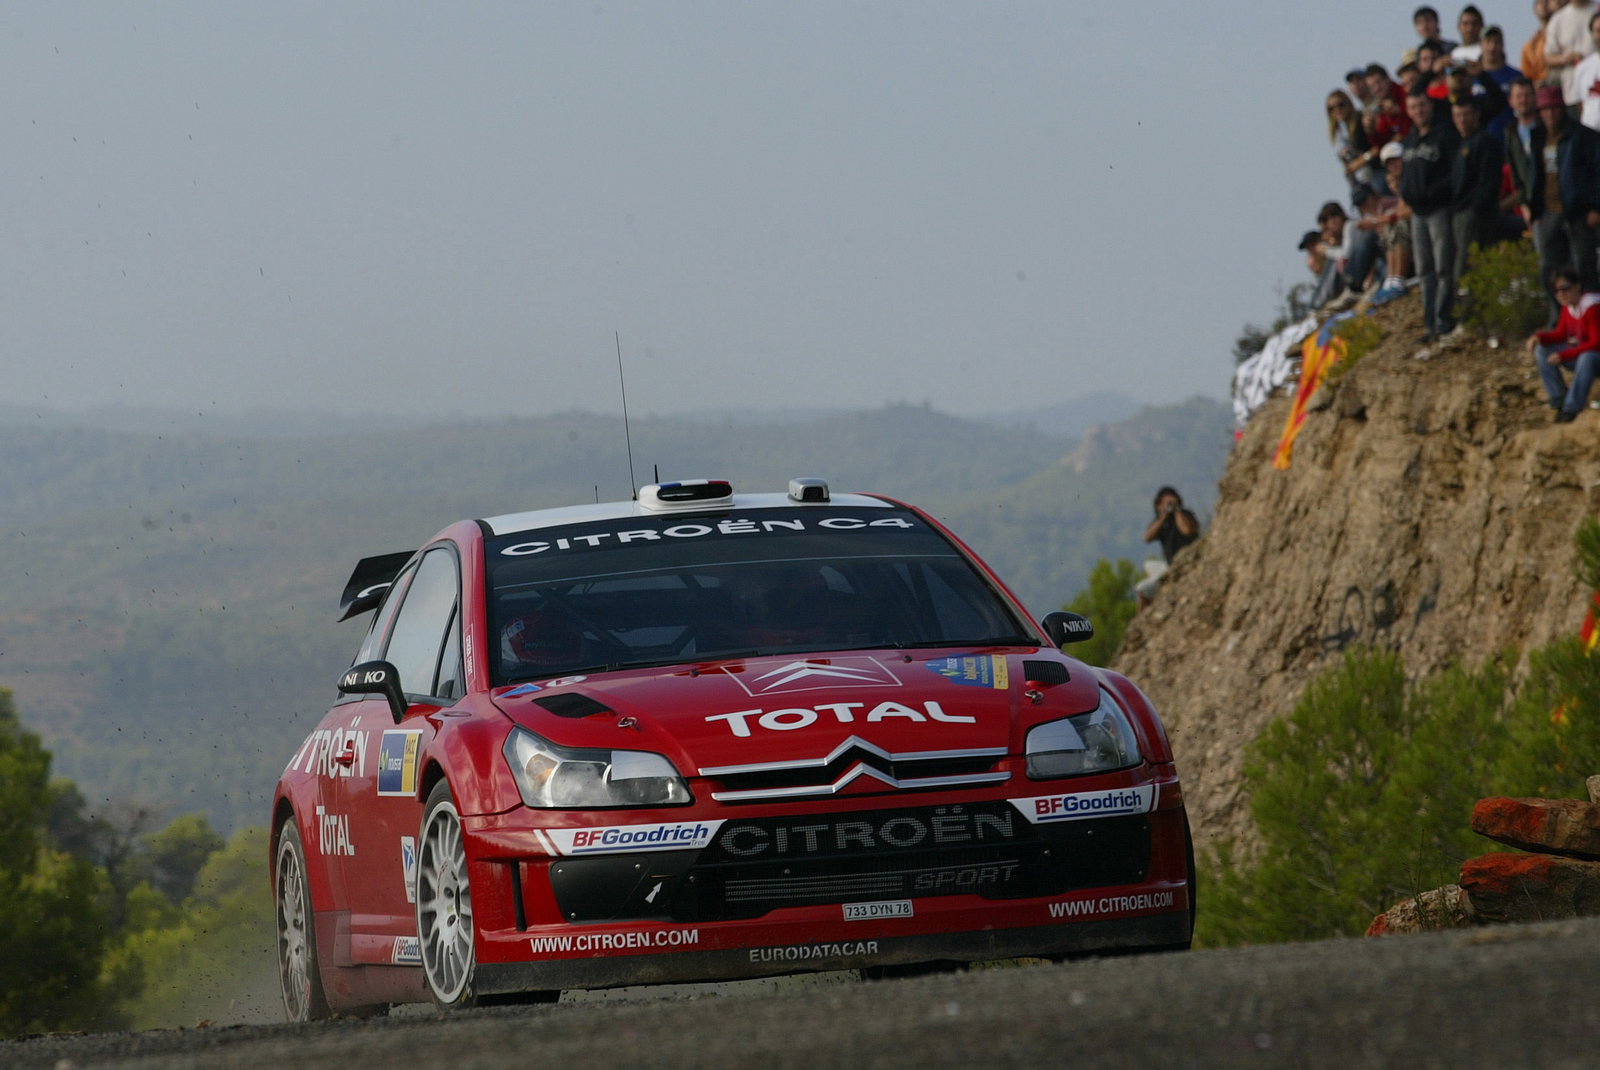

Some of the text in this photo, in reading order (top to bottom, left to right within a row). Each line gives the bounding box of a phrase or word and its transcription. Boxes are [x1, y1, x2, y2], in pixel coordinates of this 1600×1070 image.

[500, 517, 914, 557] CITROËN C4
[704, 701, 977, 738] TOTAL
[1035, 791, 1142, 815] BFGoodrich
[572, 823, 709, 847] BFGoodrich
[720, 805, 1014, 856] CITROËN
[913, 864, 1020, 890] SPORT
[846, 903, 910, 917] 733 DYN 78
[1048, 892, 1174, 918] WWW.CITROEN.COM
[530, 929, 699, 953] WWW.CITROEN.COM
[749, 941, 879, 963] EURODATACAR
